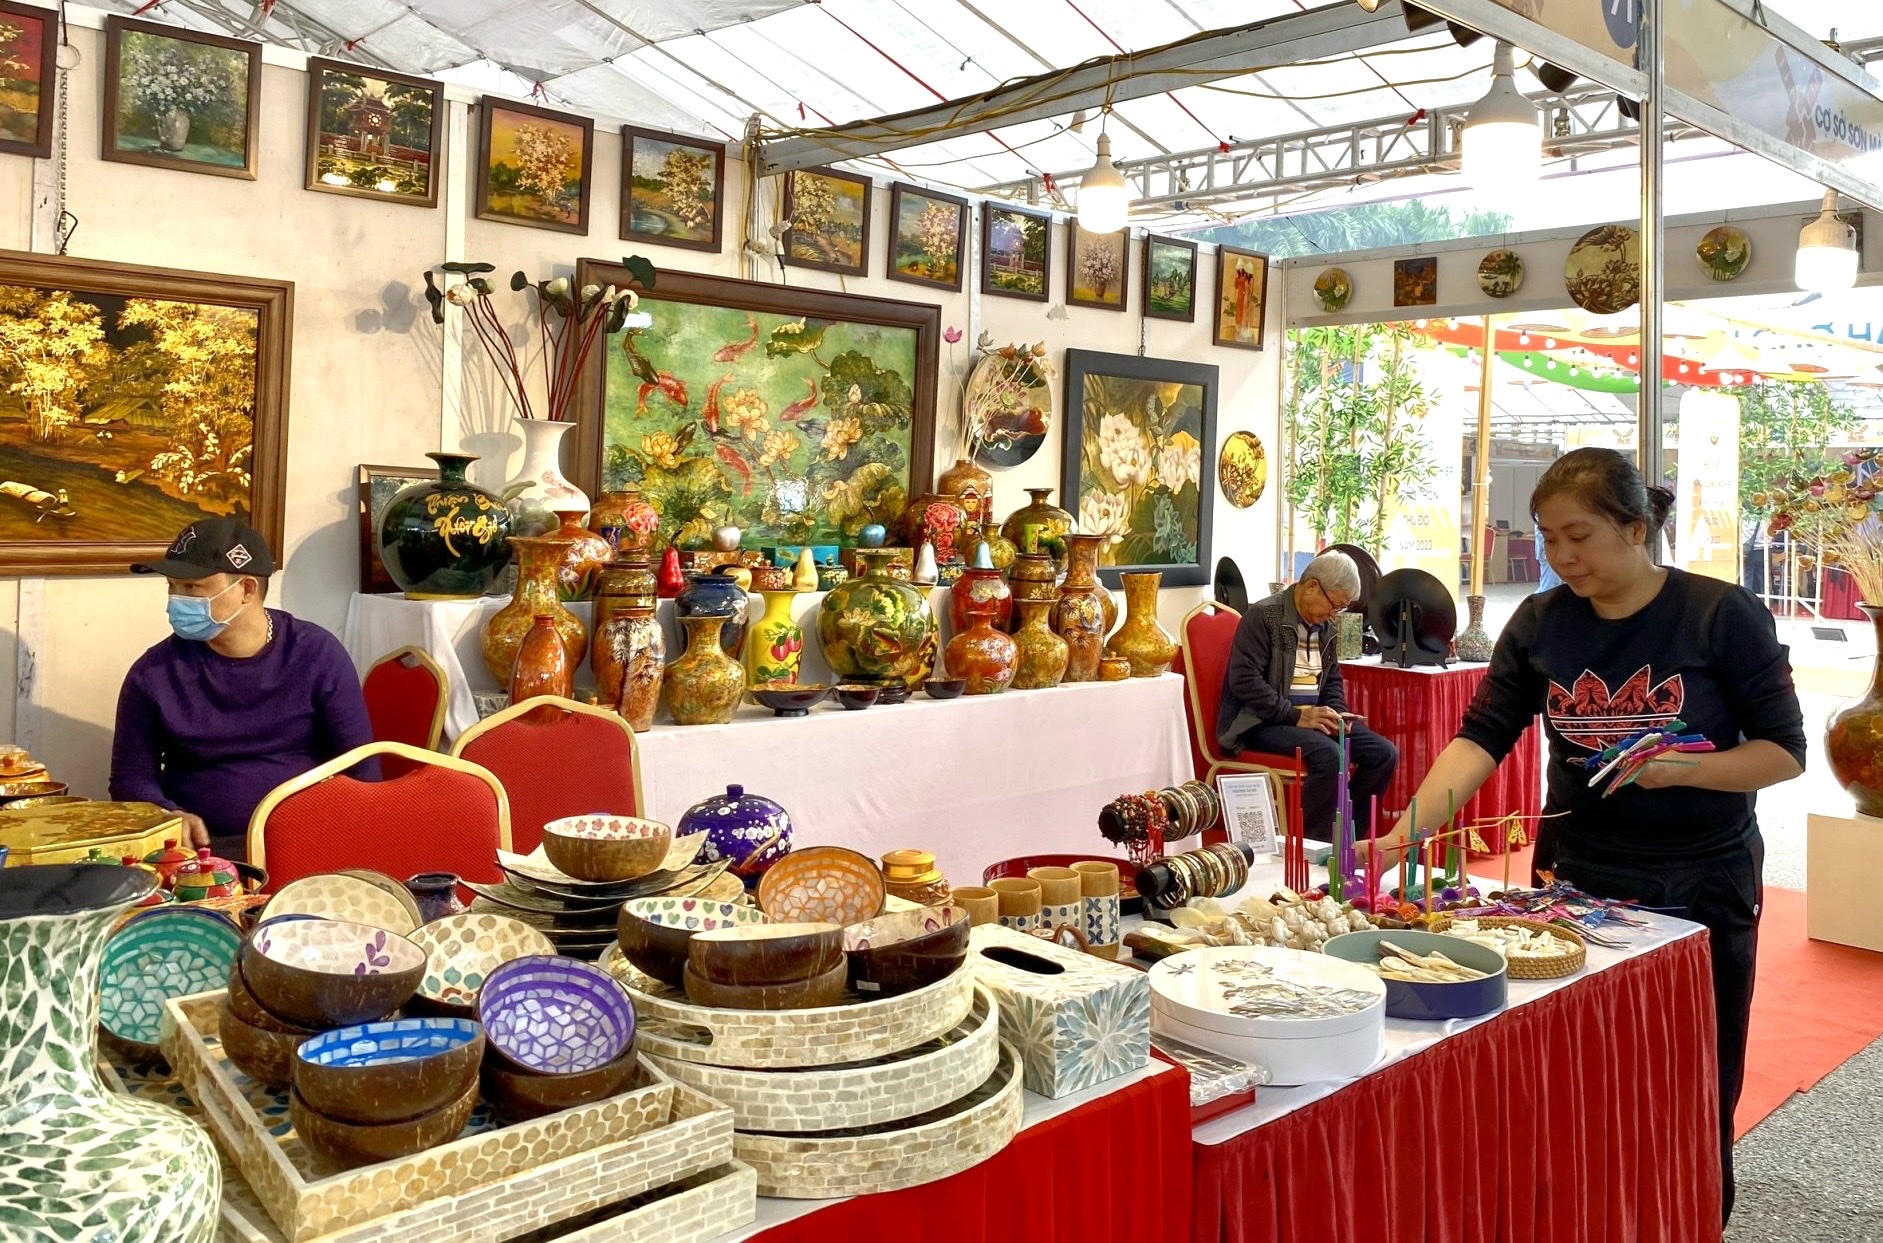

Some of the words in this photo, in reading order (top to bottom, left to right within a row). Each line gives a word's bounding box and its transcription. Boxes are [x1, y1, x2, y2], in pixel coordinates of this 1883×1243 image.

[1833, 109, 1846, 141] SỞ
[1848, 123, 1867, 153] SƠN
[1416, 539, 1433, 550] 2023
